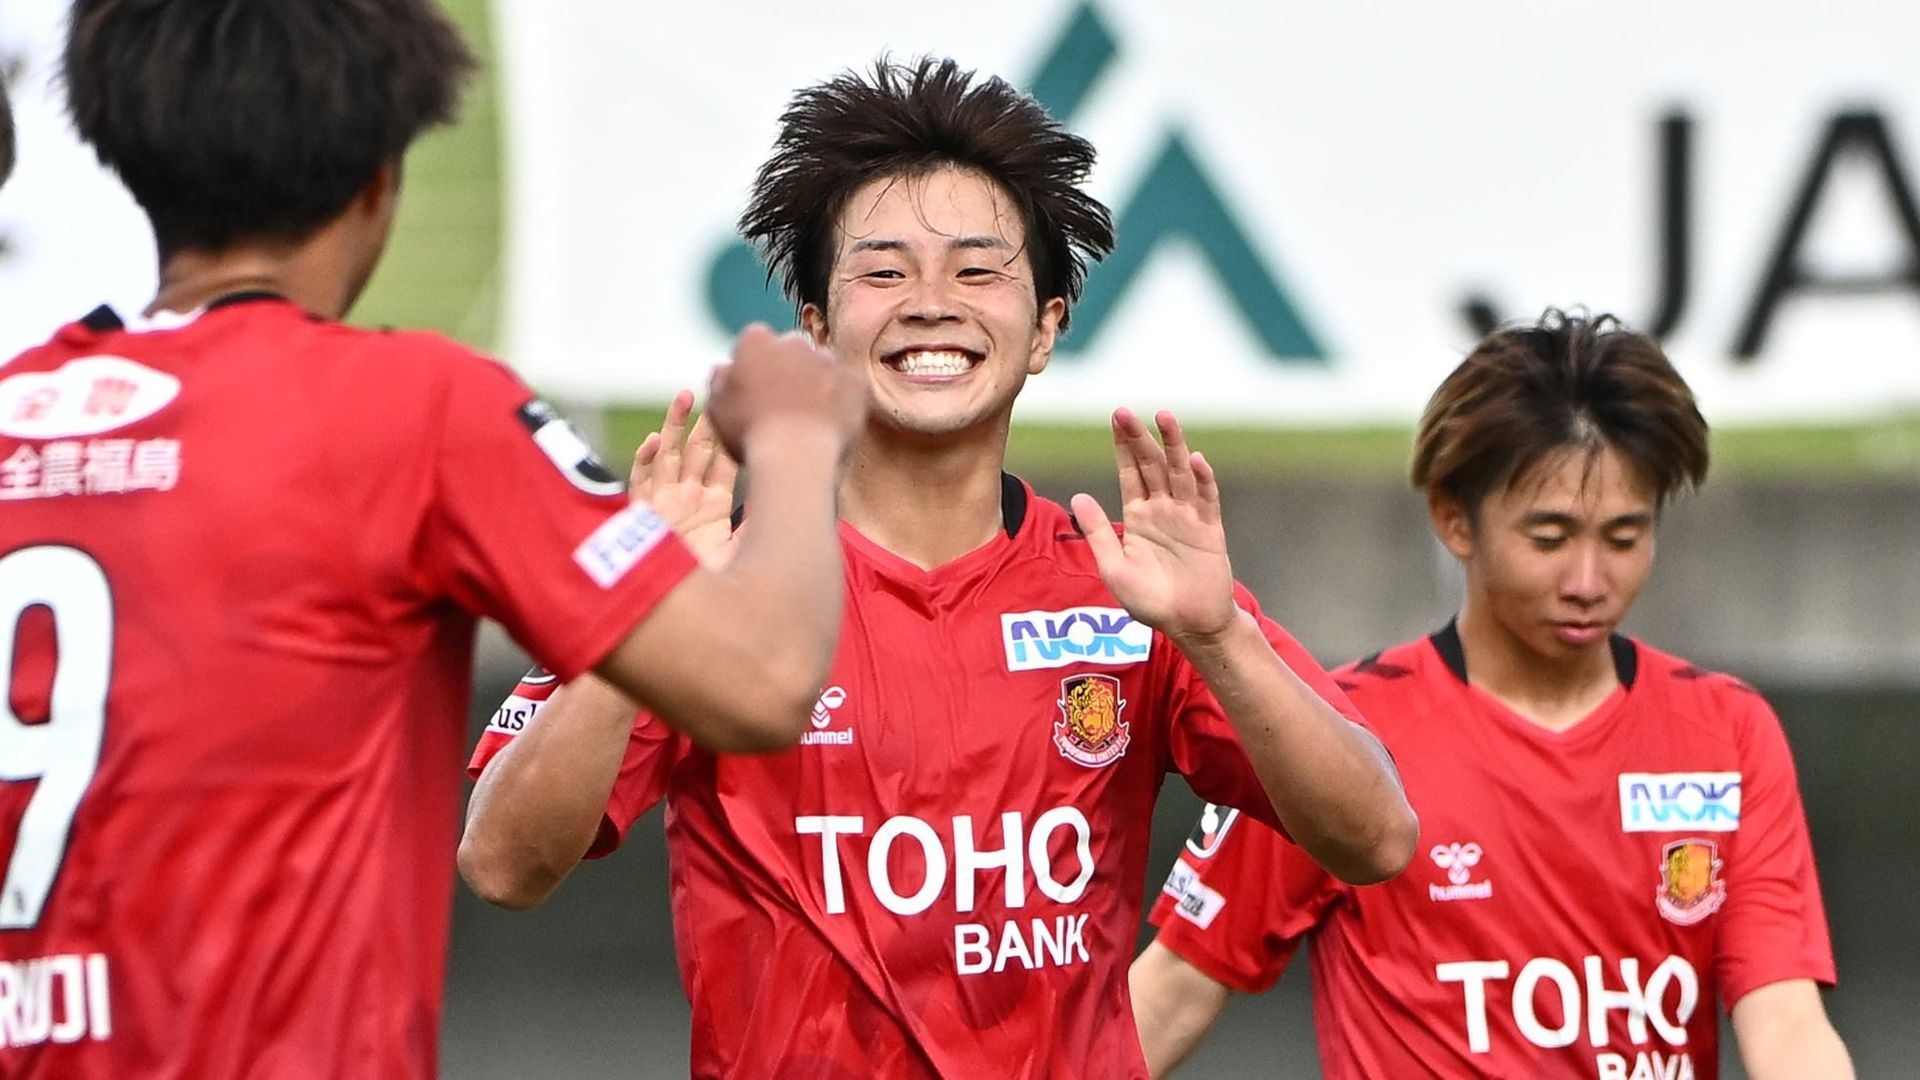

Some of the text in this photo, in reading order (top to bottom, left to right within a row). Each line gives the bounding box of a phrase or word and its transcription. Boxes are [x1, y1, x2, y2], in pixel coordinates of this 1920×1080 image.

[1011, 612, 1147, 662] NOK
[800, 727, 853, 745] ummel
[1631, 782, 1741, 822] NOK
[795, 806, 1095, 915] TOHO
[1429, 879, 1492, 902] hummel
[954, 914, 1090, 975] BANK
[1436, 955, 1699, 1054] TOHO
